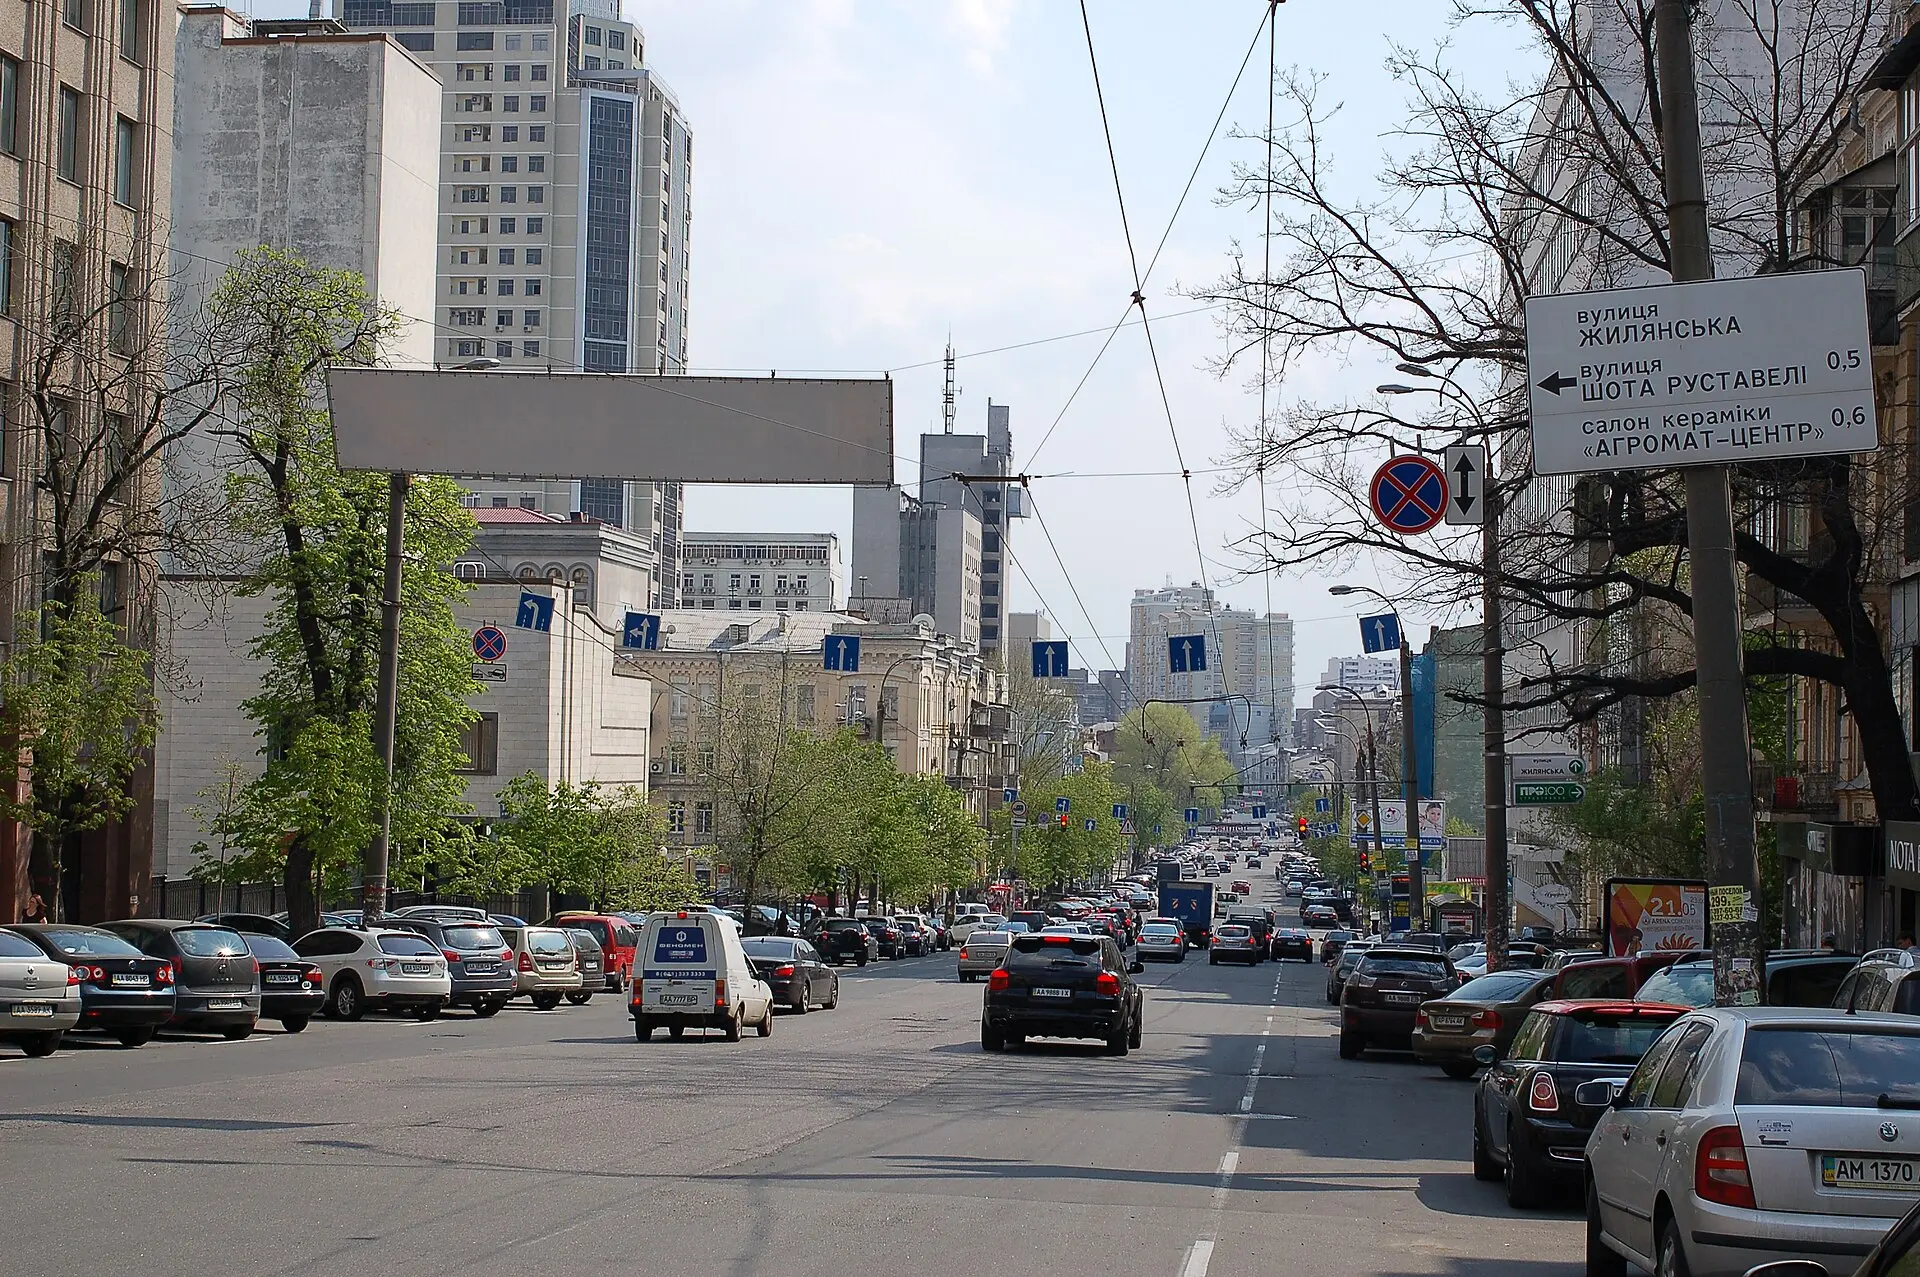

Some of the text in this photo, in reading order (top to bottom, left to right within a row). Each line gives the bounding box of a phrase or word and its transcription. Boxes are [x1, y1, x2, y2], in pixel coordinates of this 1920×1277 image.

[1576, 304, 1659, 325] вулиця
[1578, 315, 1742, 348] ЖИЛЯНСЬКА
[1580, 357, 1663, 379] вулиця
[1582, 350, 1861, 402] ШОТА РУСТАВЕЛІ 0,5
[1582, 404, 1866, 435] салон кераміки 0,6
[1890, 840, 1915, 872] NOTA
[1719, 886, 1743, 895] ПОСЕЛОК
[1836, 1160, 1913, 1182] AM 1370
